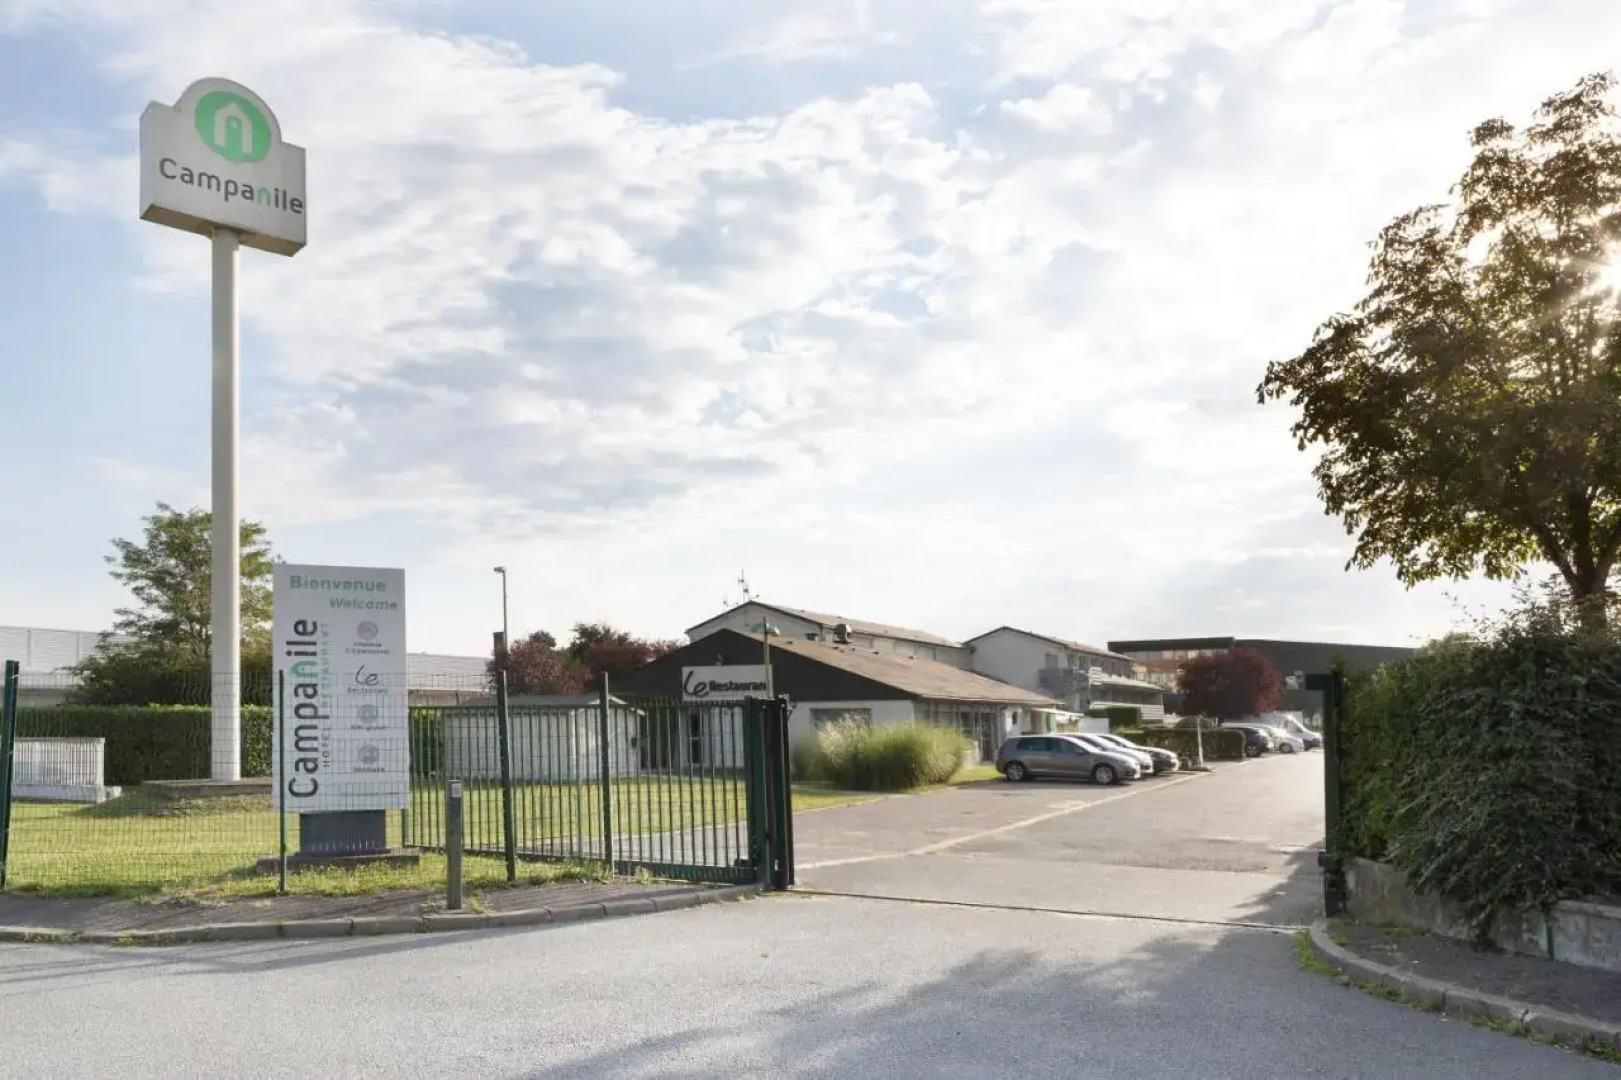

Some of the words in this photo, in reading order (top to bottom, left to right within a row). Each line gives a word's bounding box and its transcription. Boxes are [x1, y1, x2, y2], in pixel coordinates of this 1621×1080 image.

[159, 157, 304, 214] Campanile
[289, 575, 386, 591] Bienvenue
[329, 598, 398, 610] Welcome
[355, 664, 379, 686] Le
[683, 670, 709, 697] Le
[708, 680, 768, 691] Restauran
[286, 619, 329, 798] Campanile
